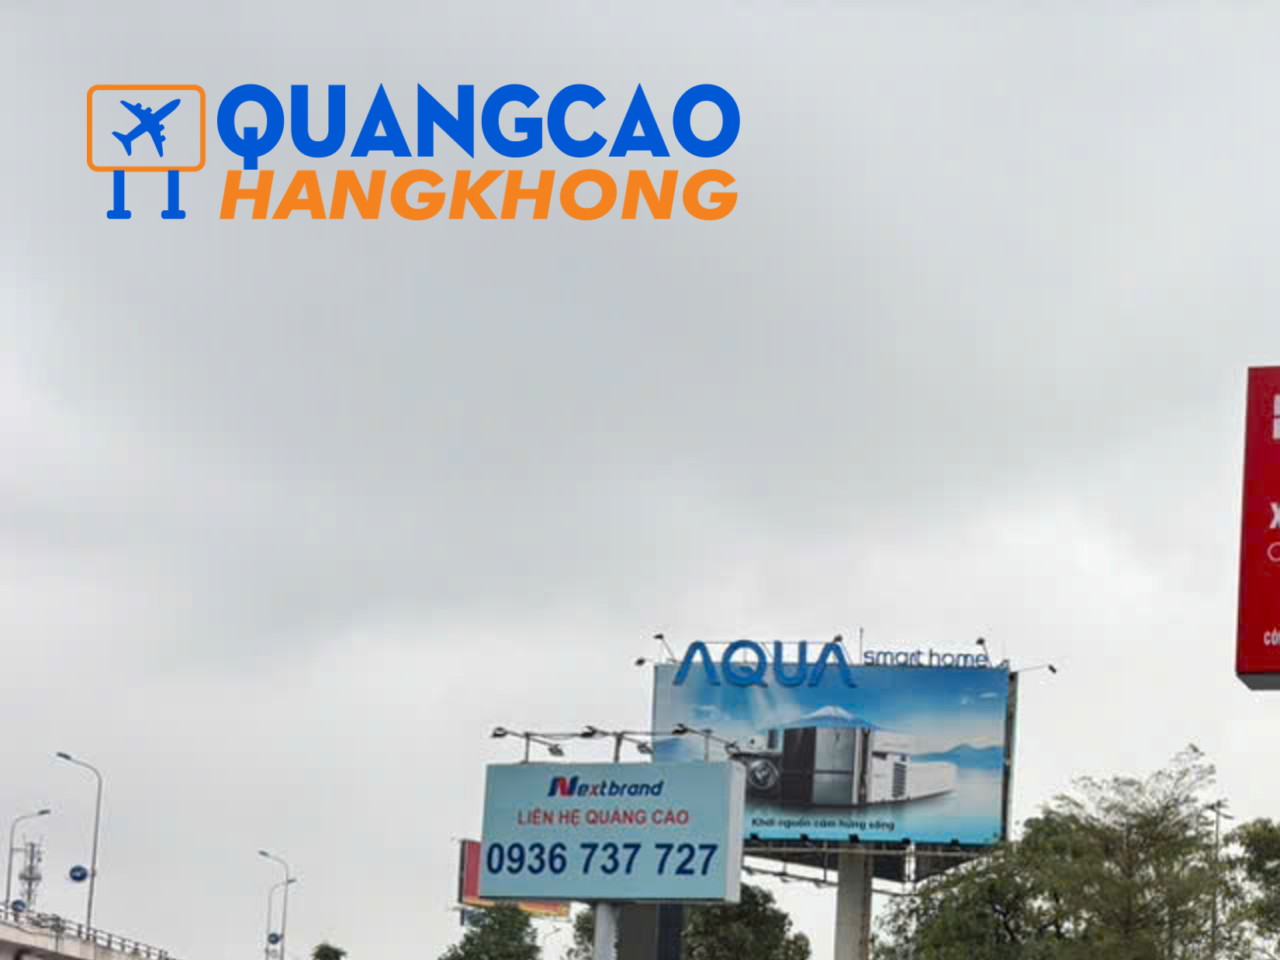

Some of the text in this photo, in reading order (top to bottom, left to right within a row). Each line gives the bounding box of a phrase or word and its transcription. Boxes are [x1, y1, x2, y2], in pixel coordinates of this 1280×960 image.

[673, 639, 990, 688] AQUA smart home
[548, 775, 665, 798] Nextbrand
[518, 807, 554, 826] LIÊN
[559, 808, 581, 827] HỆ
[486, 842, 718, 876] 0936 737 727
